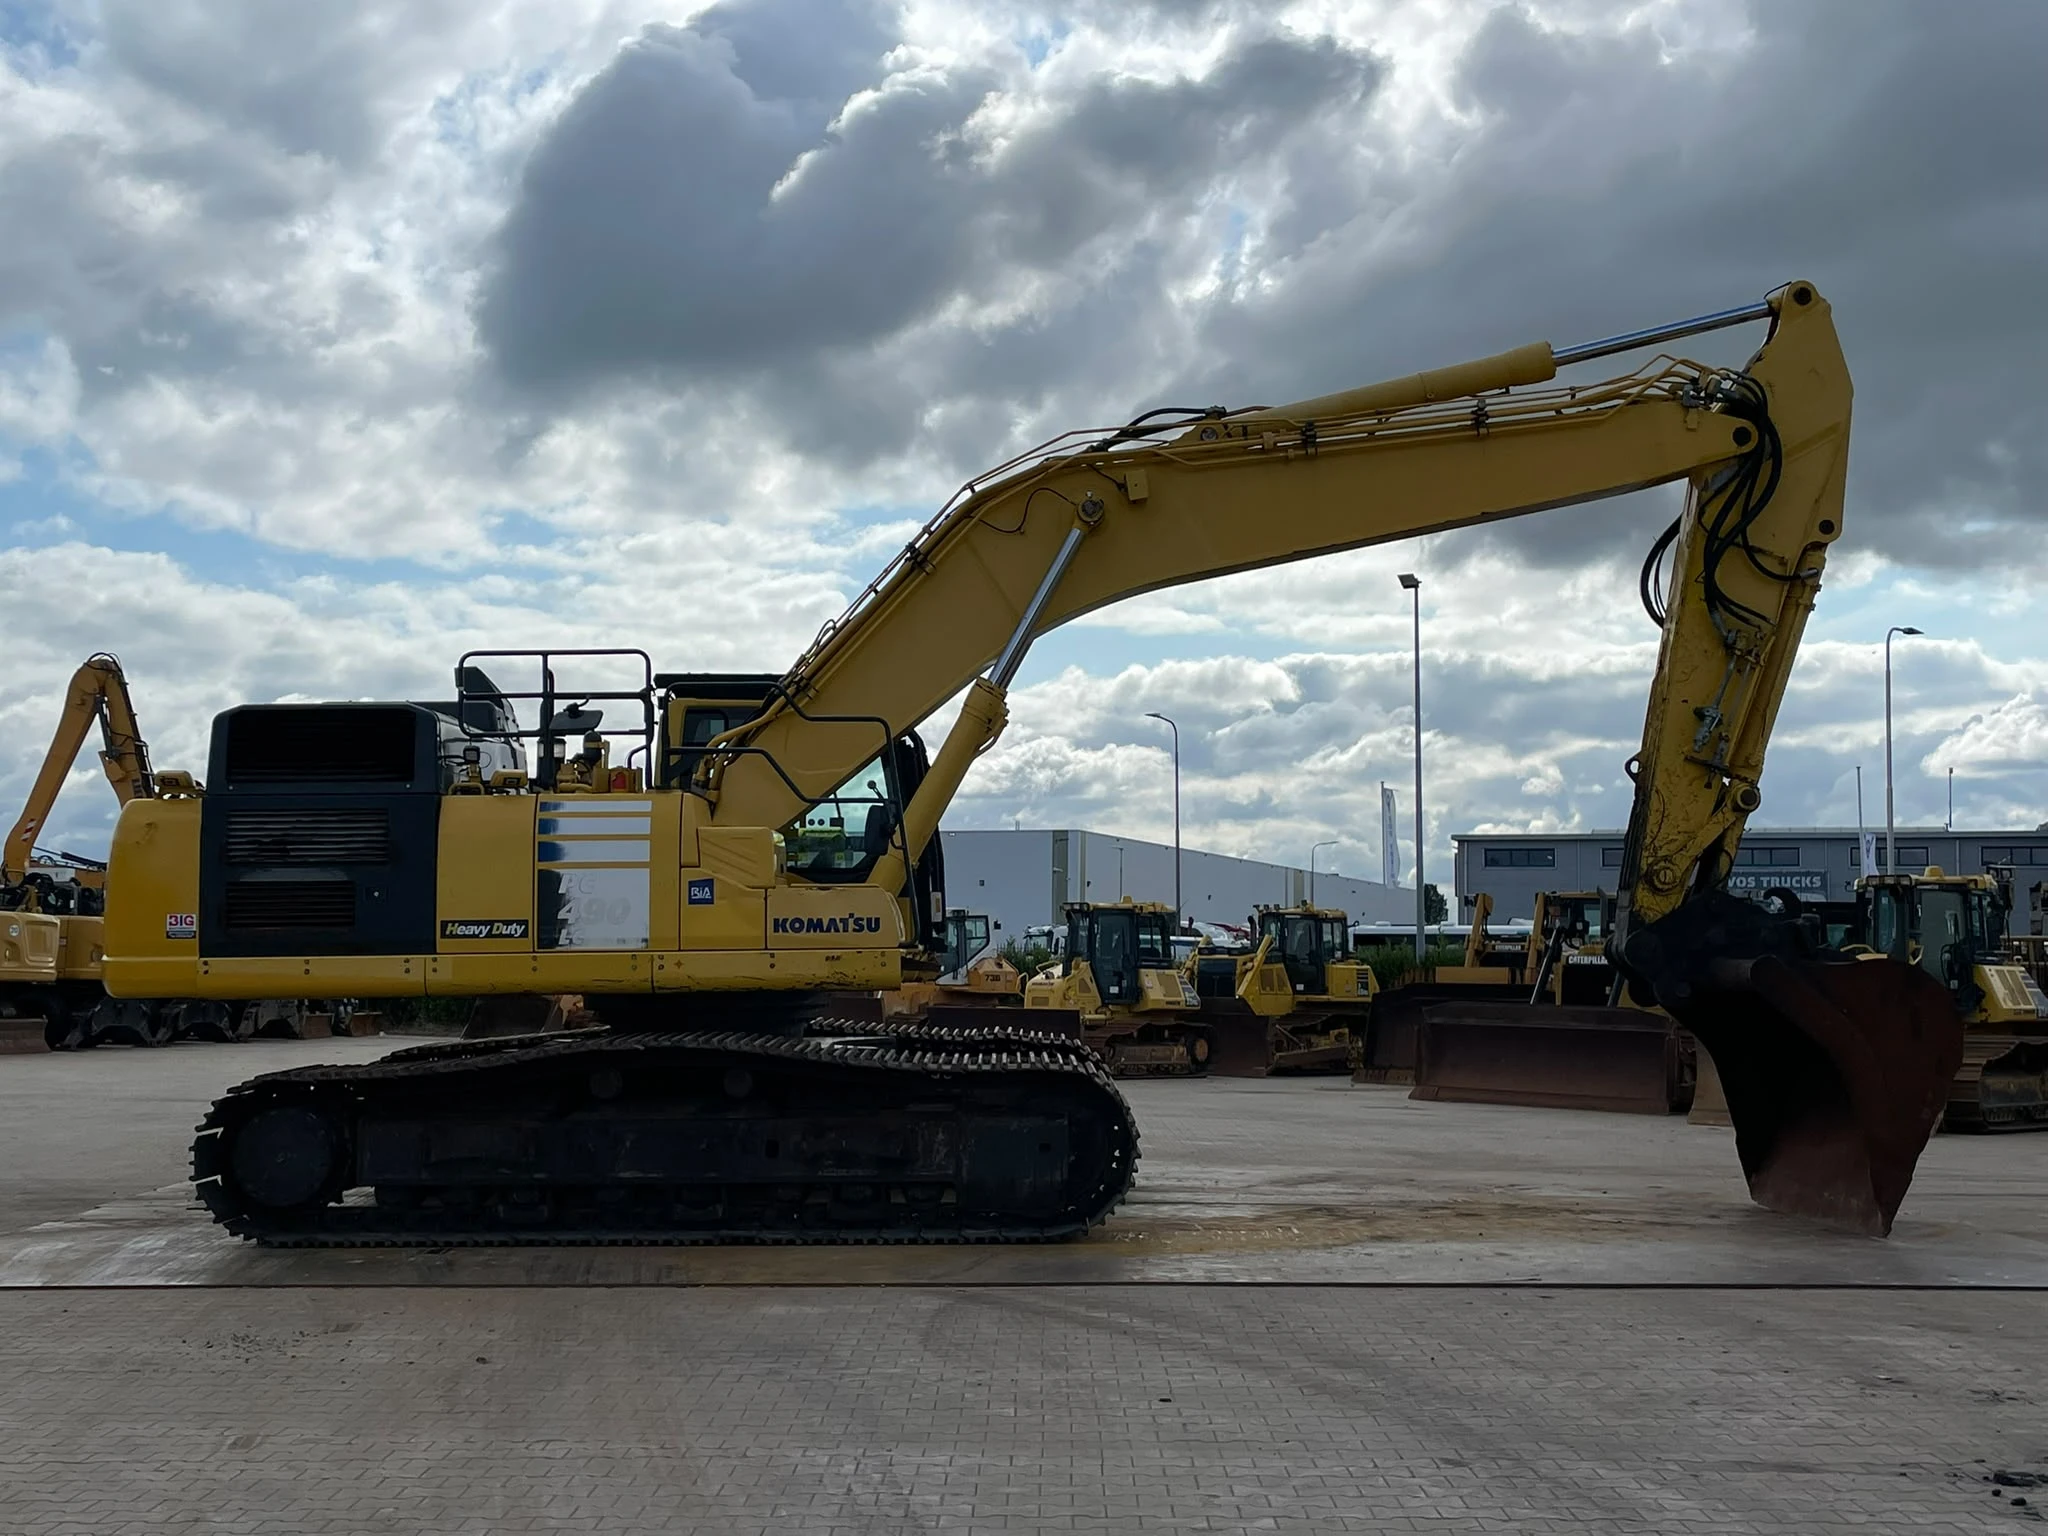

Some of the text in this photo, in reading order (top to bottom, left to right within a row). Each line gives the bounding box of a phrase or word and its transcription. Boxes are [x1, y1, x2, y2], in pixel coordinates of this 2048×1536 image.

[558, 873, 596, 894] PC
[1728, 876, 1821, 888] VOS TRUCKS
[557, 897, 631, 925] 490
[446, 922, 525, 937] Heavy Duty
[773, 913, 880, 933] KOMATSU
